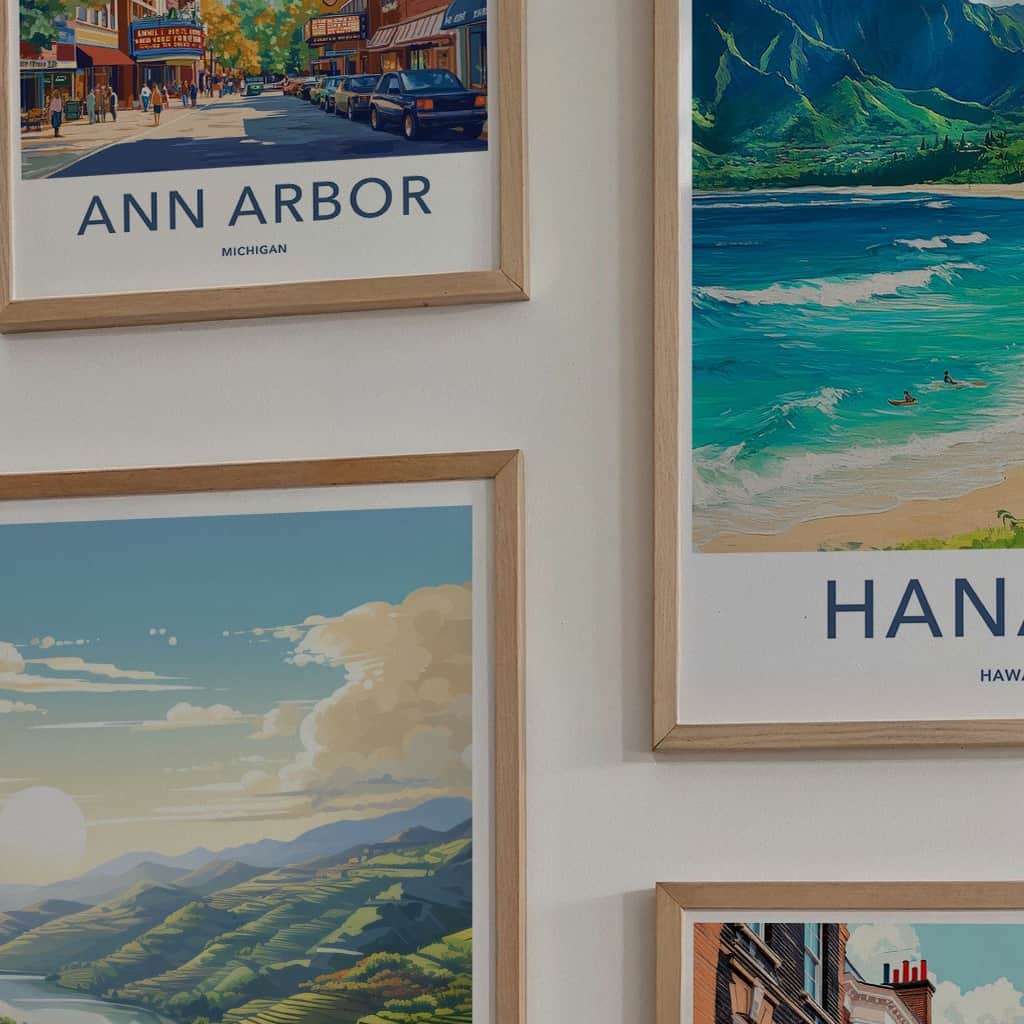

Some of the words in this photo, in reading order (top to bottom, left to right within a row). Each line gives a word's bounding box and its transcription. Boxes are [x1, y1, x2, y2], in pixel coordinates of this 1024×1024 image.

[77, 189, 205, 236] ANN
[227, 175, 432, 227] ARBOR
[221, 243, 288, 257] MICHIGAN
[827, 577, 1024, 639] HAN
[980, 668, 1024, 682] HAW
